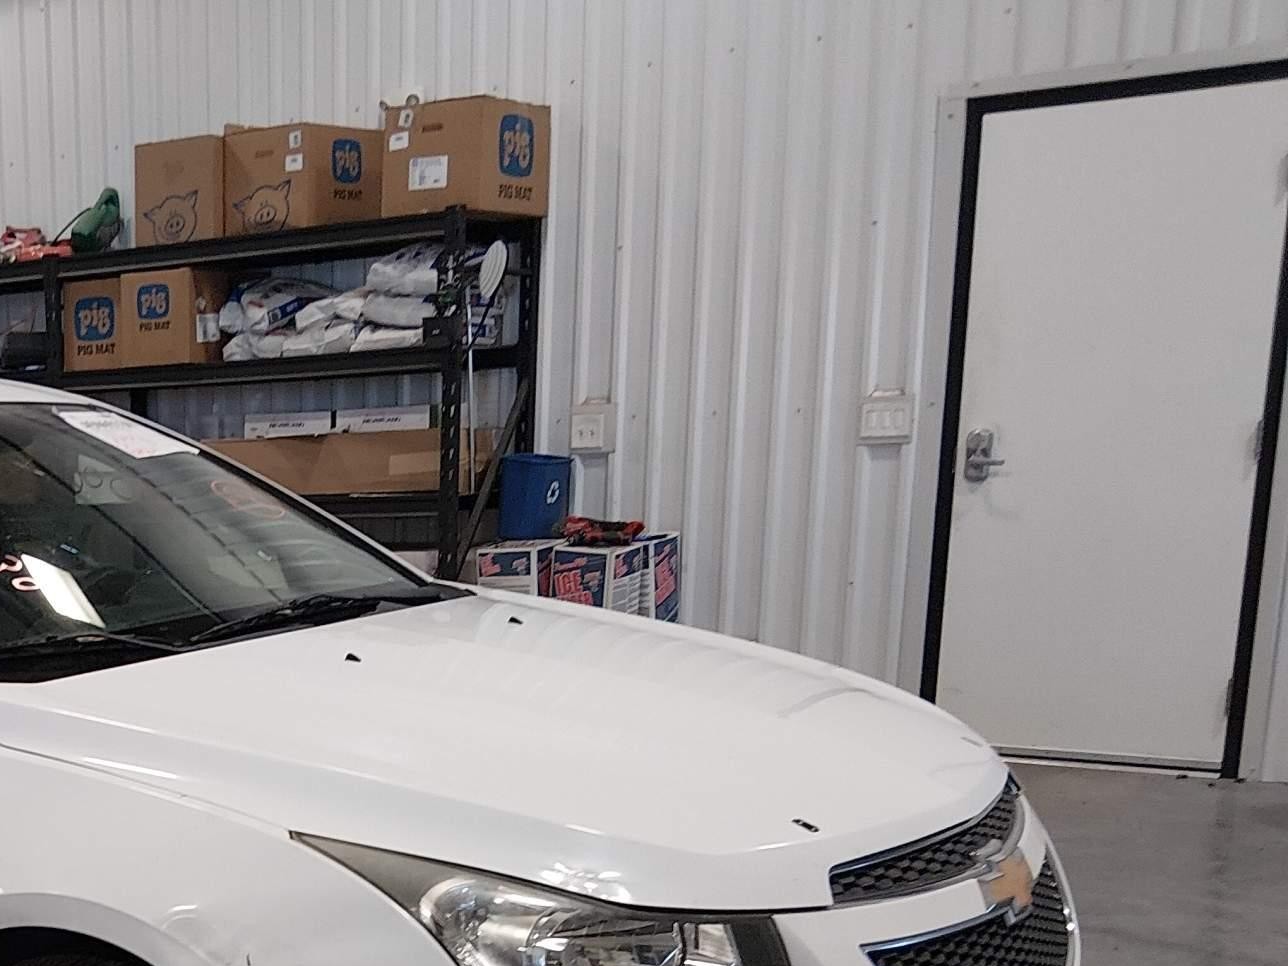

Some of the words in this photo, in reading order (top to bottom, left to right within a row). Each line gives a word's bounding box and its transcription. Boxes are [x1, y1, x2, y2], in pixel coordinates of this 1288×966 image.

[141, 287, 167, 316] pig
[78, 301, 112, 336] pig
[77, 344, 94, 356] PIG
[96, 343, 116, 355] MAT
